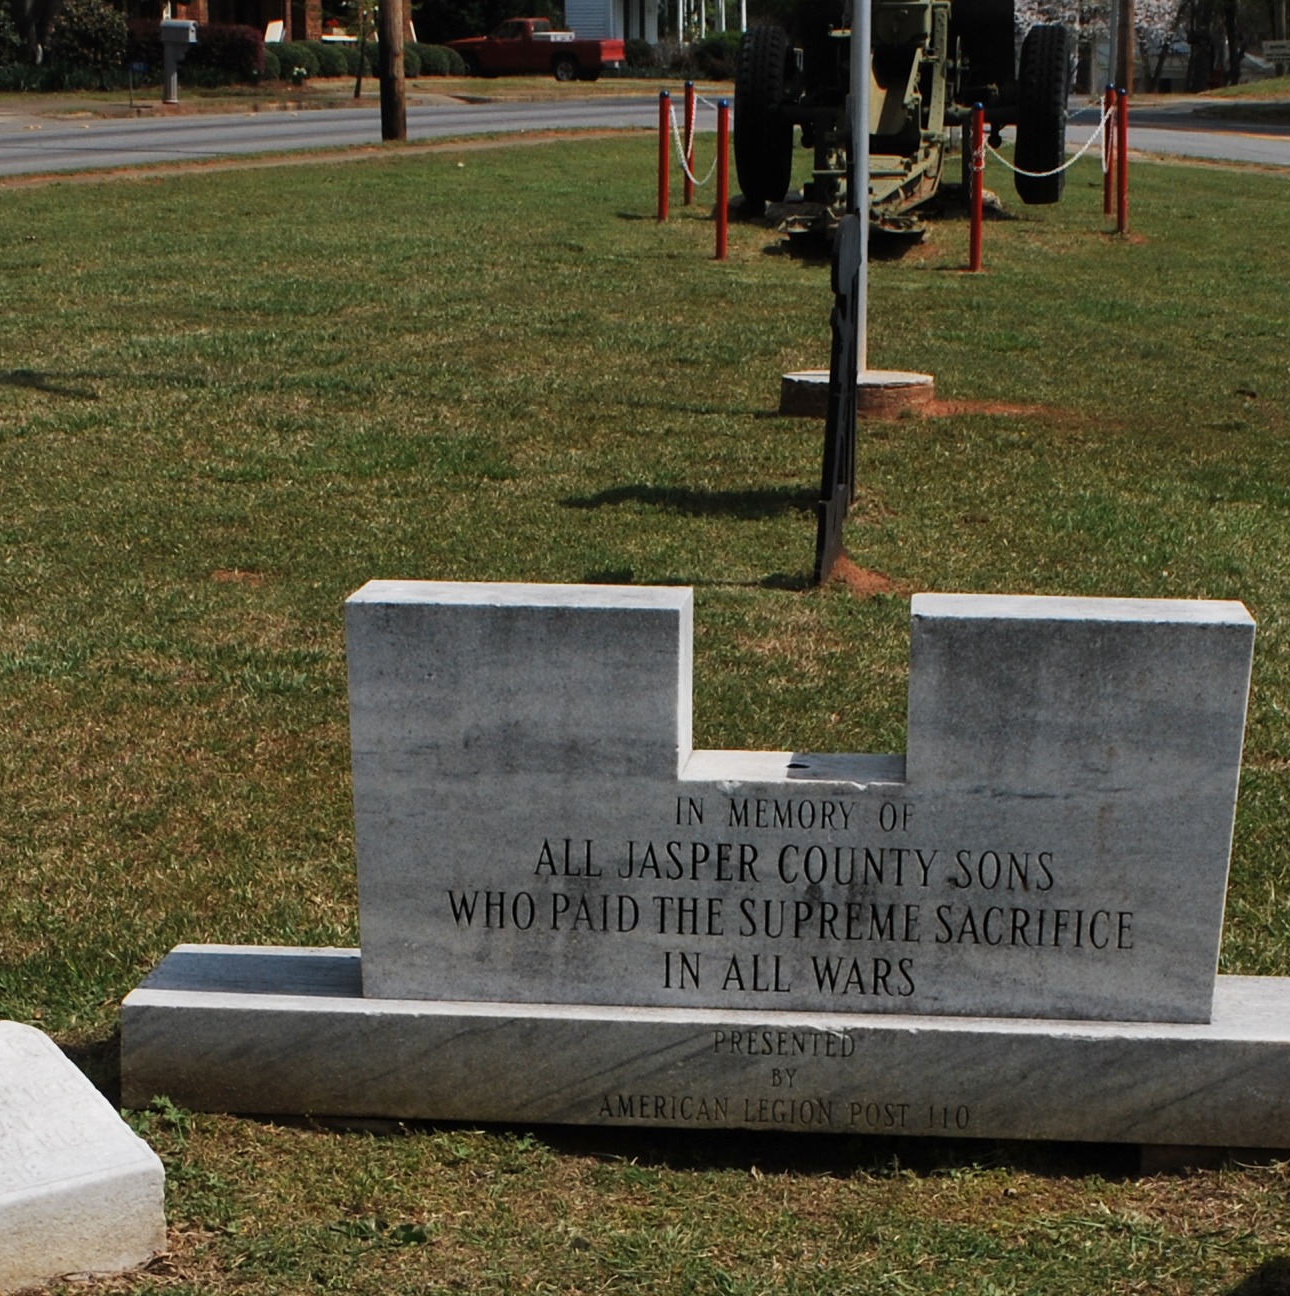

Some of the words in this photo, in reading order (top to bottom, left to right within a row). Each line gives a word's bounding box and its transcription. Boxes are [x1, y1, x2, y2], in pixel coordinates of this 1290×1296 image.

[676, 797, 704, 825] IN
[729, 798, 856, 830] MEMORY
[879, 802, 915, 832] OF
[534, 838, 602, 877] ALL
[618, 840, 760, 883] JASPER
[778, 845, 937, 887] COUNTY
[956, 850, 1054, 891] SONS
[448, 890, 535, 930] WHO
[550, 893, 640, 932] PAID
[653, 896, 724, 936] THE
[740, 899, 920, 943] SUPREME
[935, 905, 1134, 949] SACRIFICE
[663, 951, 701, 989] IN
[722, 953, 791, 992] ALL
[811, 956, 916, 996] WARS
[713, 1029, 855, 1058] PRESENTED
[771, 1068, 798, 1088] BY
[599, 1096, 729, 1121] AMERICAN
[744, 1099, 832, 1125] LEGION
[849, 1102, 911, 1128] POST
[928, 1105, 970, 1130] 110
